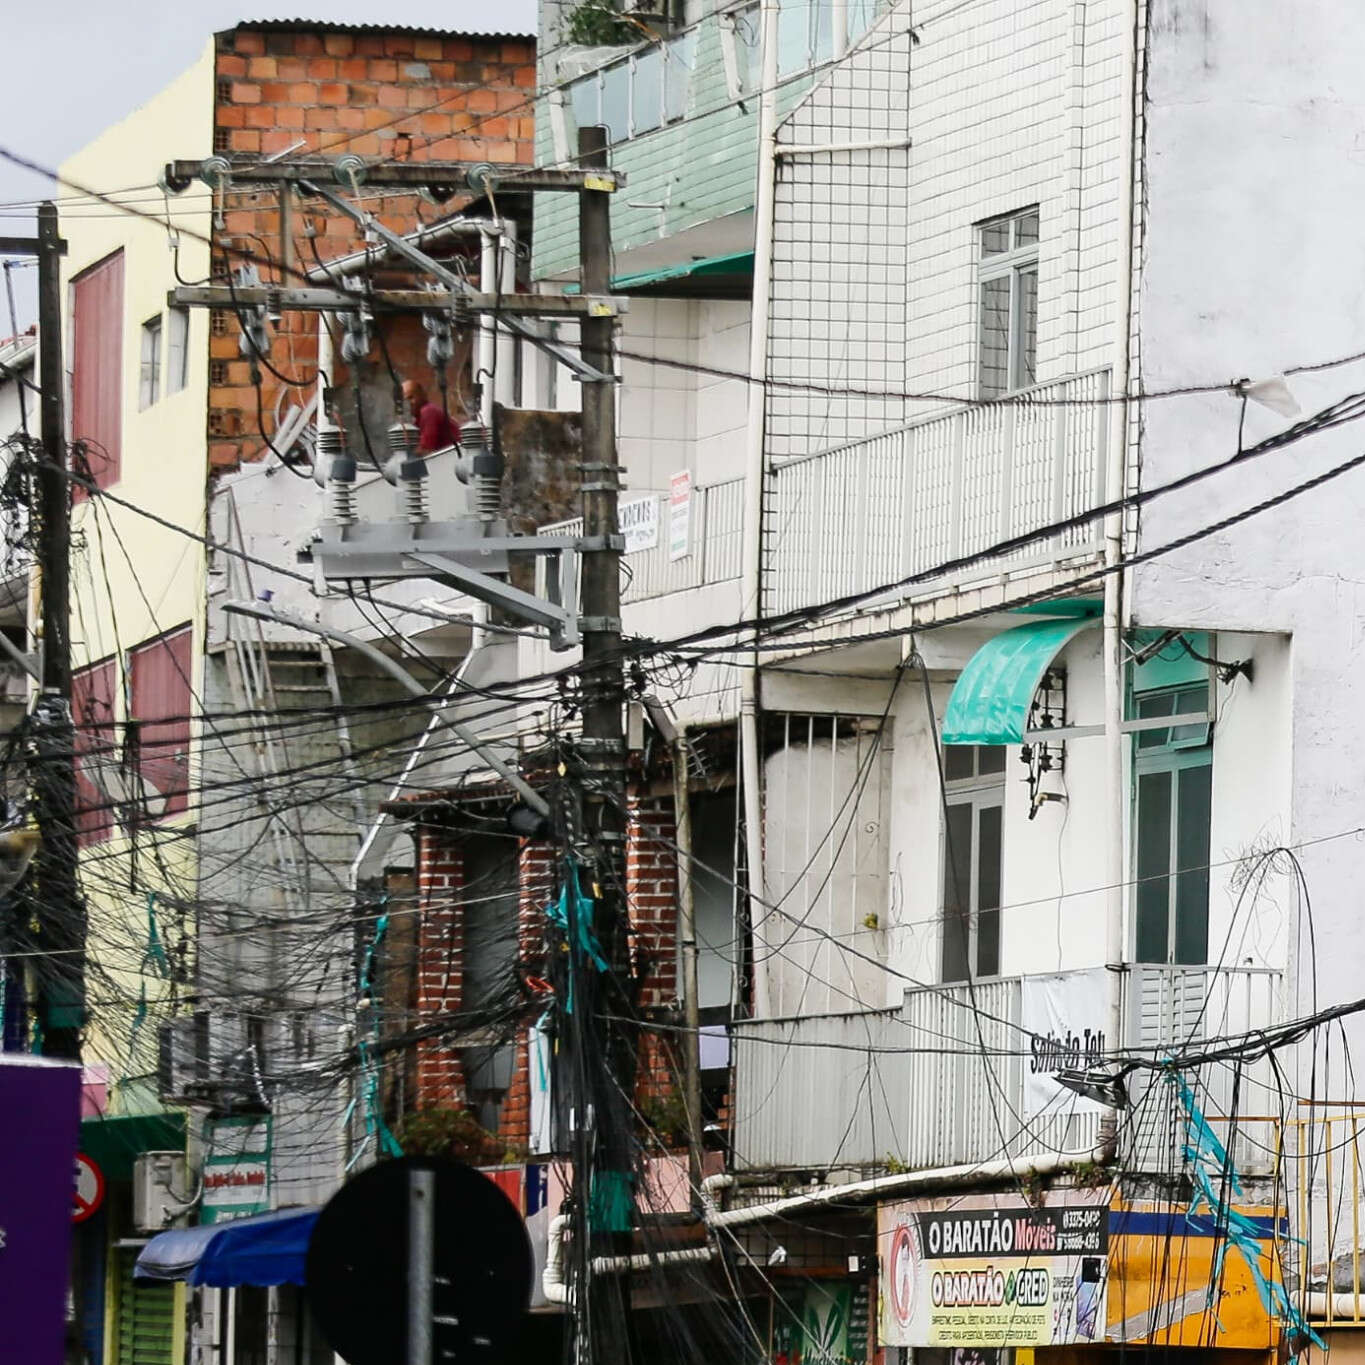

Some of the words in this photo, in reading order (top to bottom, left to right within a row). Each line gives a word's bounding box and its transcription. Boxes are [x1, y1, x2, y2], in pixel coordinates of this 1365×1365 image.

[929, 1221, 941, 1254] O
[943, 1211, 1013, 1253] BARATÃO
[1014, 1215, 1056, 1250] Móveis
[933, 1271, 943, 1306] O
[943, 1265, 1004, 1306] BARATÃO
